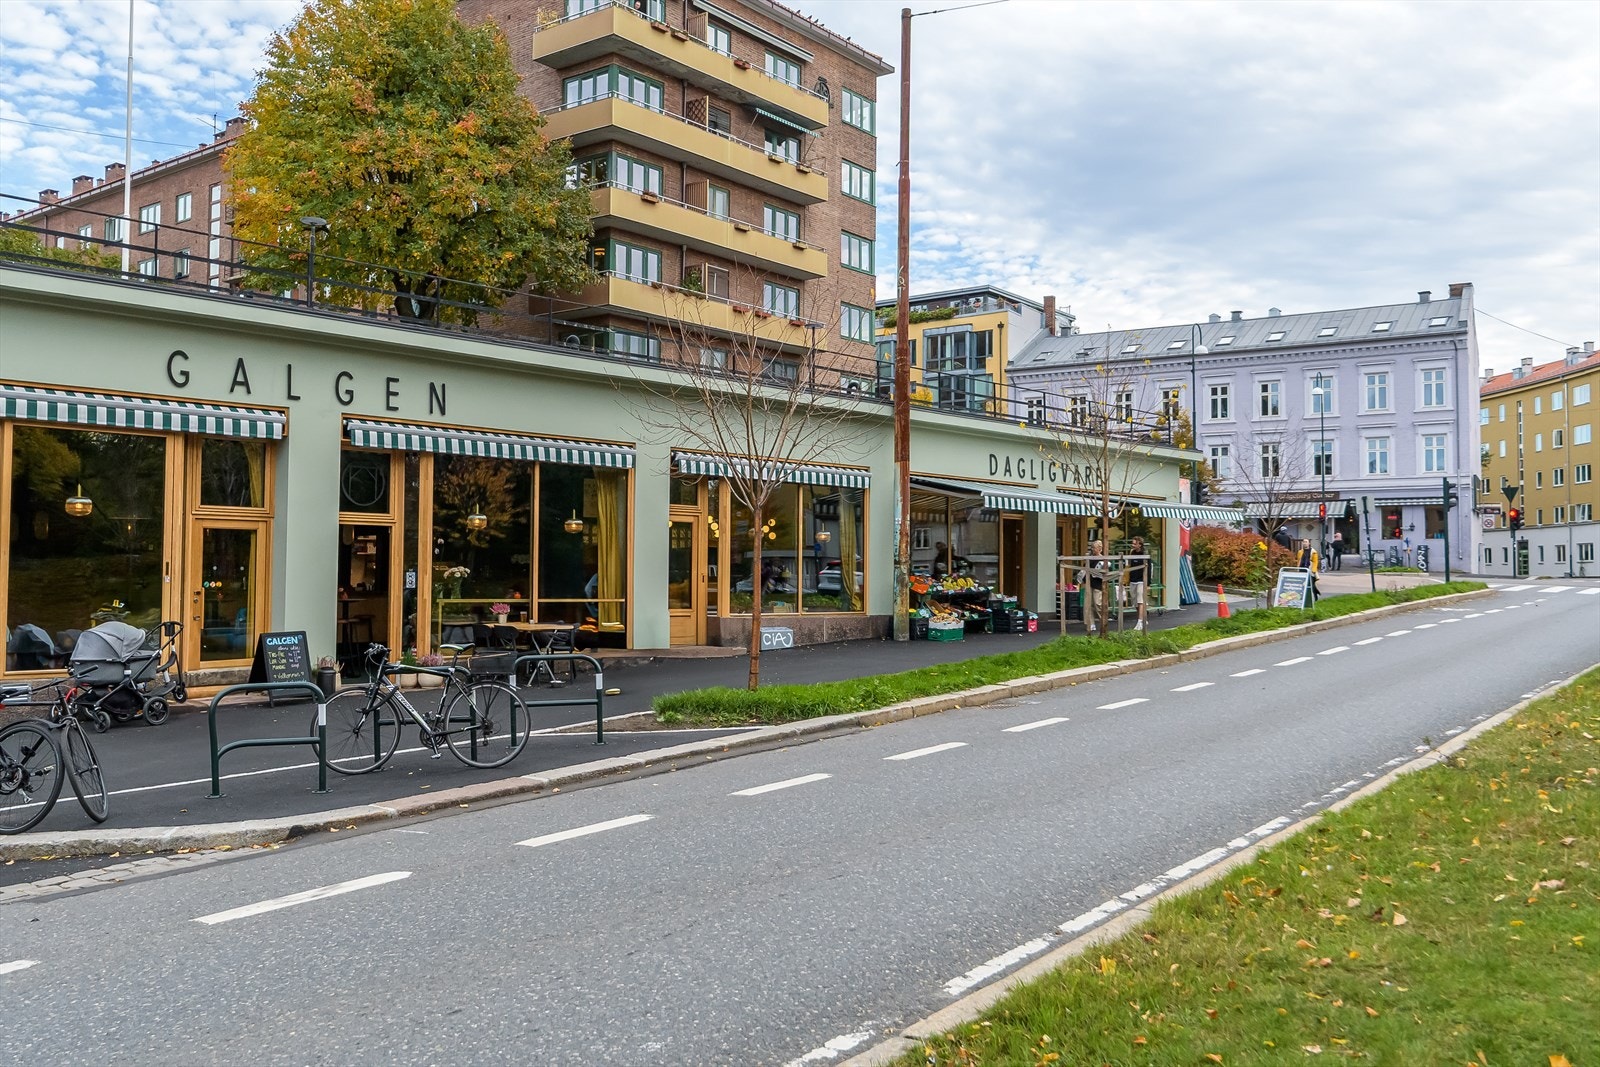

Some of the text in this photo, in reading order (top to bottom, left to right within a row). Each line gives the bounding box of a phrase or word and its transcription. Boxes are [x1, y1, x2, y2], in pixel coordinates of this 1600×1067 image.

[166, 349, 447, 416] GALGEN
[989, 453, 1103, 487] DAGLIGVARE
[267, 637, 298, 645] GALGEN
